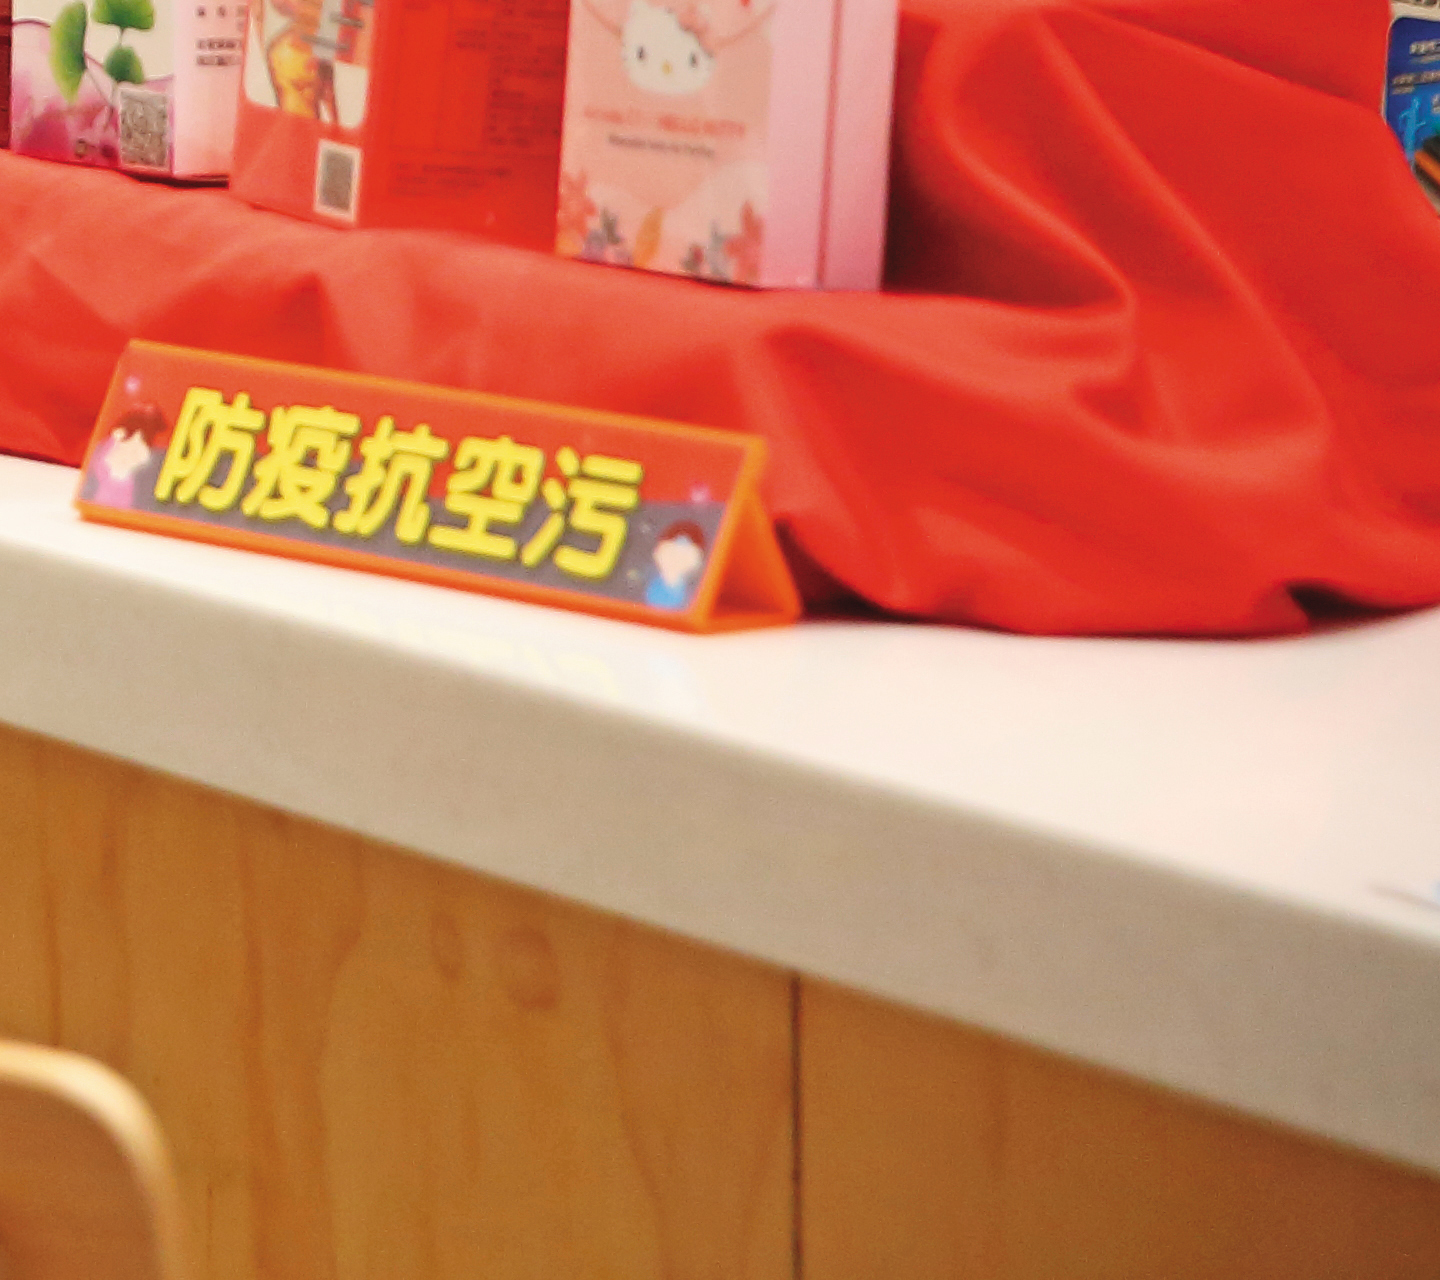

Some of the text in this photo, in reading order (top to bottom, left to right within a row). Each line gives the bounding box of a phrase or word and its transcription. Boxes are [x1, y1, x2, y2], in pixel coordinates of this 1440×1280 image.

[154, 385, 646, 580] 防疫抗空污
